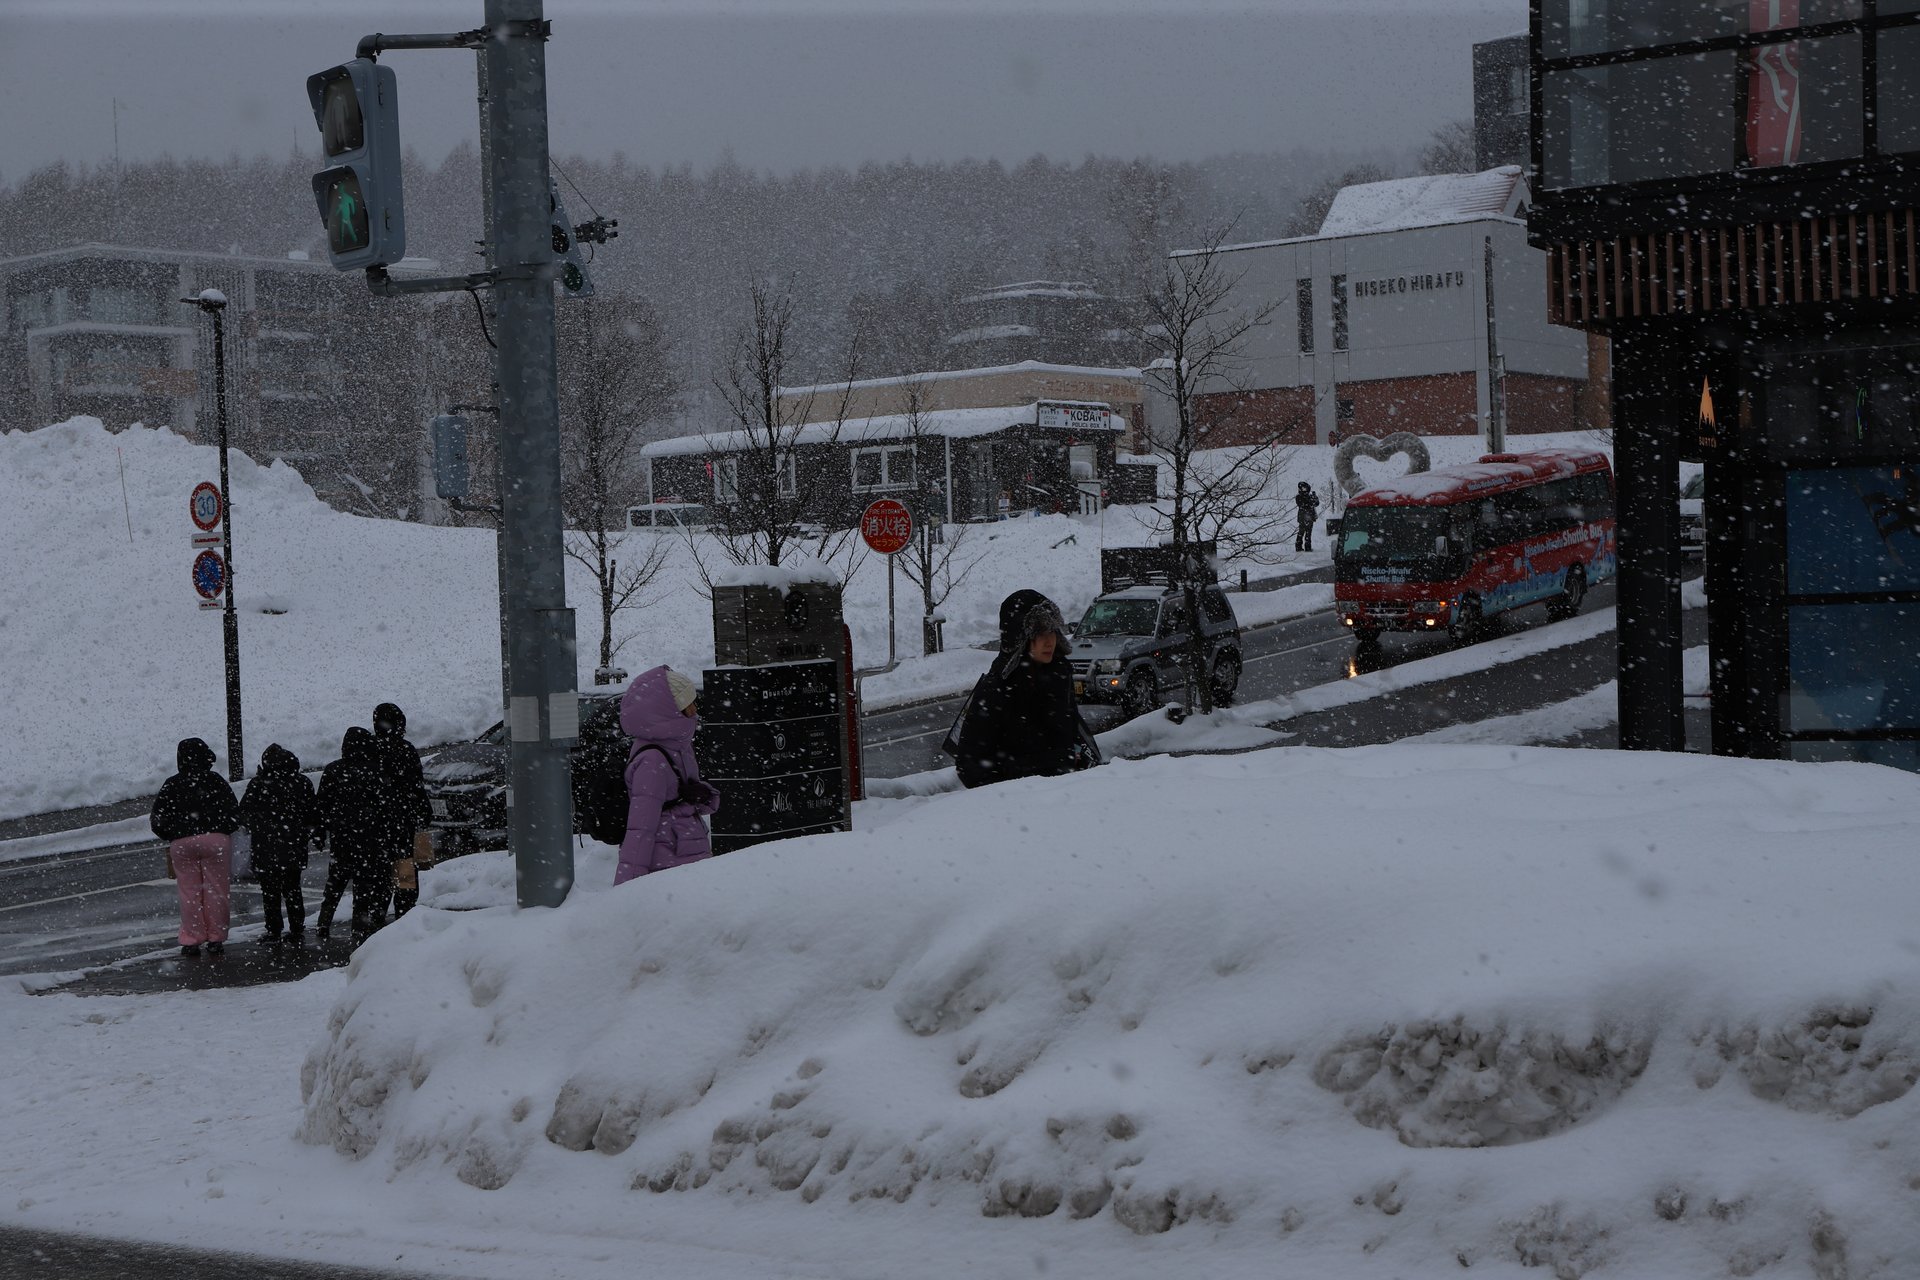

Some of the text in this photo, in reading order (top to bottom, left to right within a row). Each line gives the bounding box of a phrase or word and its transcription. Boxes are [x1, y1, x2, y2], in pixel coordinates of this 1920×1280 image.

[1355, 271, 1464, 297] NISEKO HIRAFU
[198, 496, 215, 517] 30
[865, 515, 909, 537] 消火栓
[1589, 523, 1603, 539] Bus
